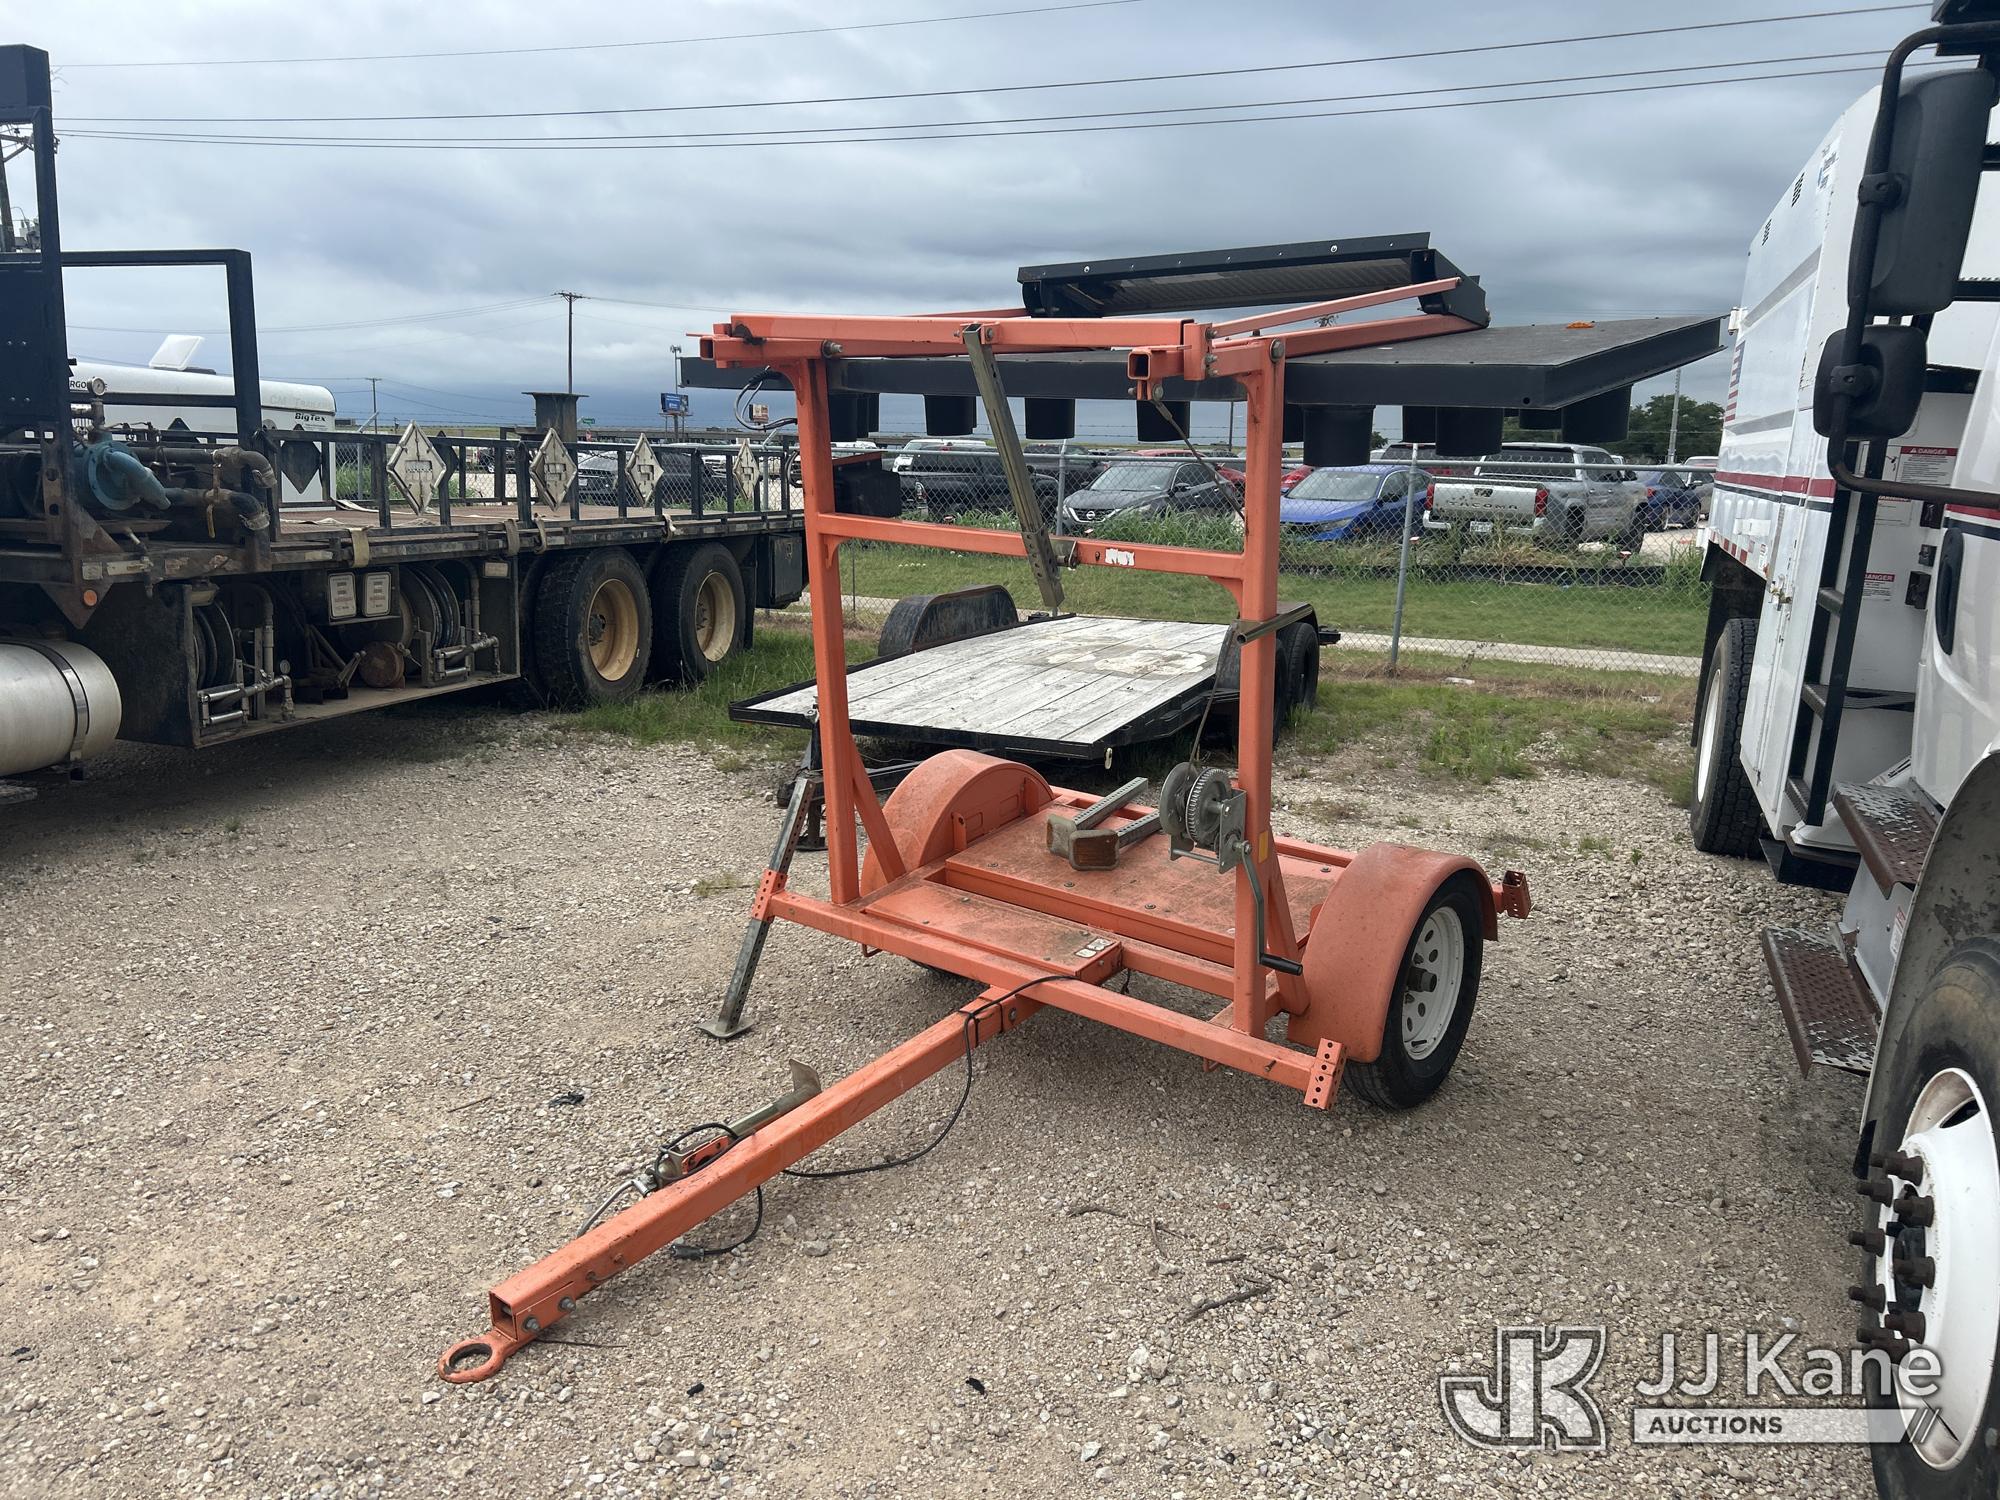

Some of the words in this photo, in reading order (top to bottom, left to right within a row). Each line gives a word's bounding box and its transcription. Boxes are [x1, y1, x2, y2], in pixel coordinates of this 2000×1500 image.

[69, 380, 87, 389] RGO
[294, 413, 327, 422] BigTex
[1448, 501, 1519, 510] TACOMA
